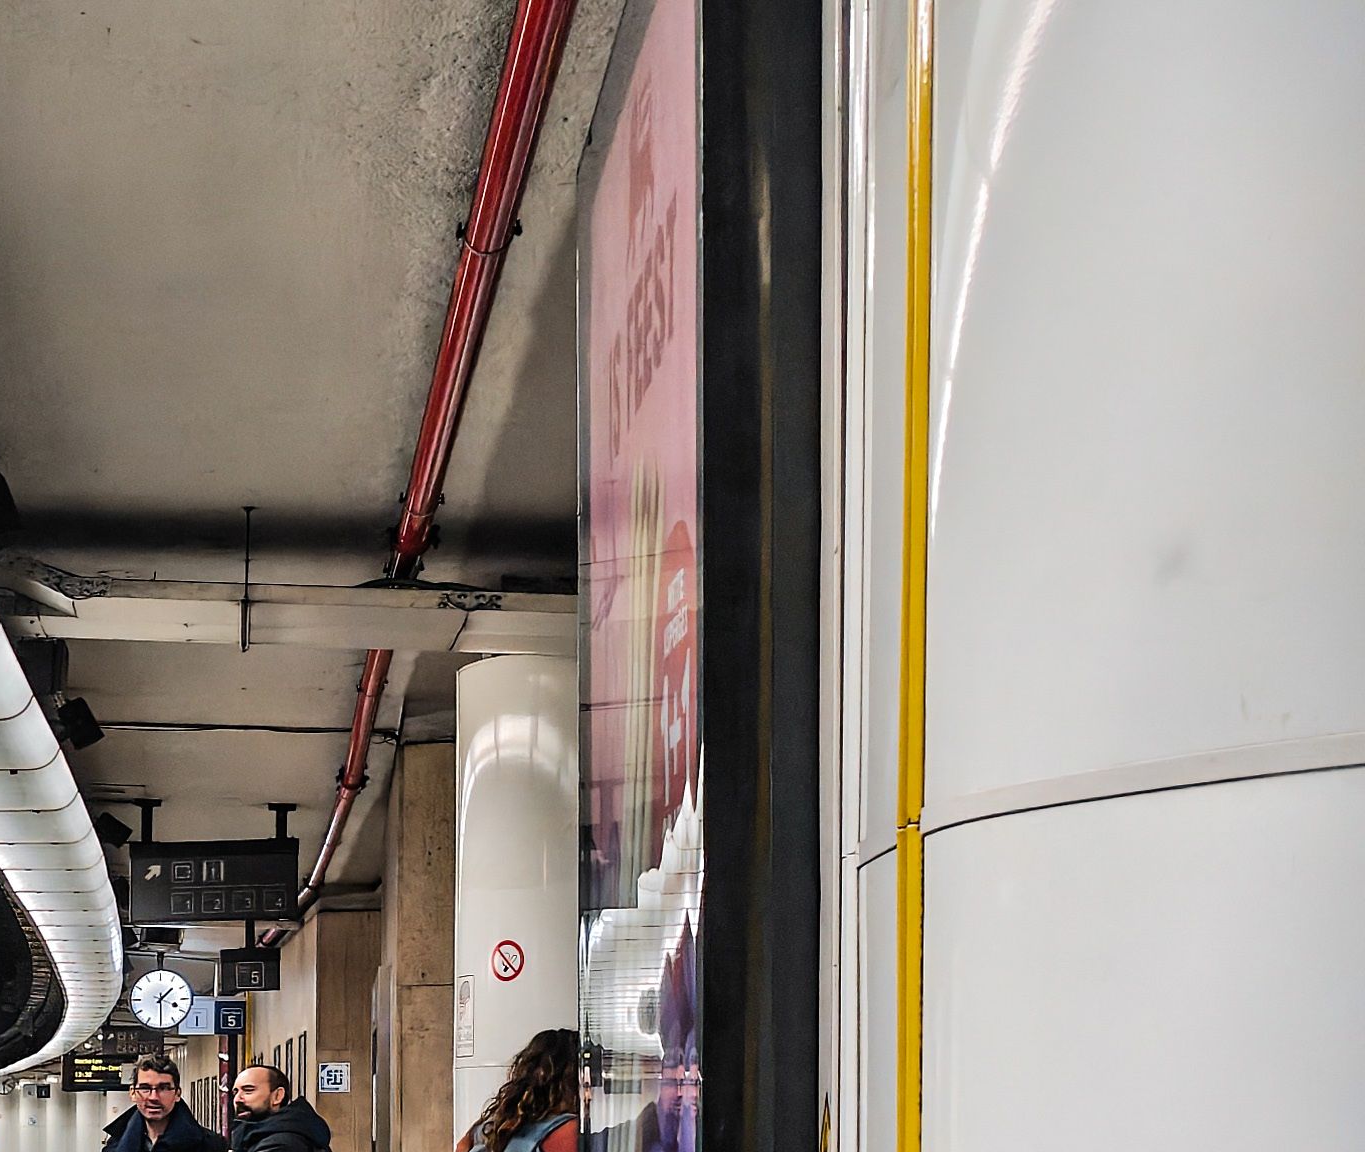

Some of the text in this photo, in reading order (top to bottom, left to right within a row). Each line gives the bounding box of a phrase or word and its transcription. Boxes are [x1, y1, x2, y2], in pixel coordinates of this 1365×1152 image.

[627, 186, 677, 431] FEEST
[251, 970, 260, 984] 5
[227, 1015, 236, 1027] 5
